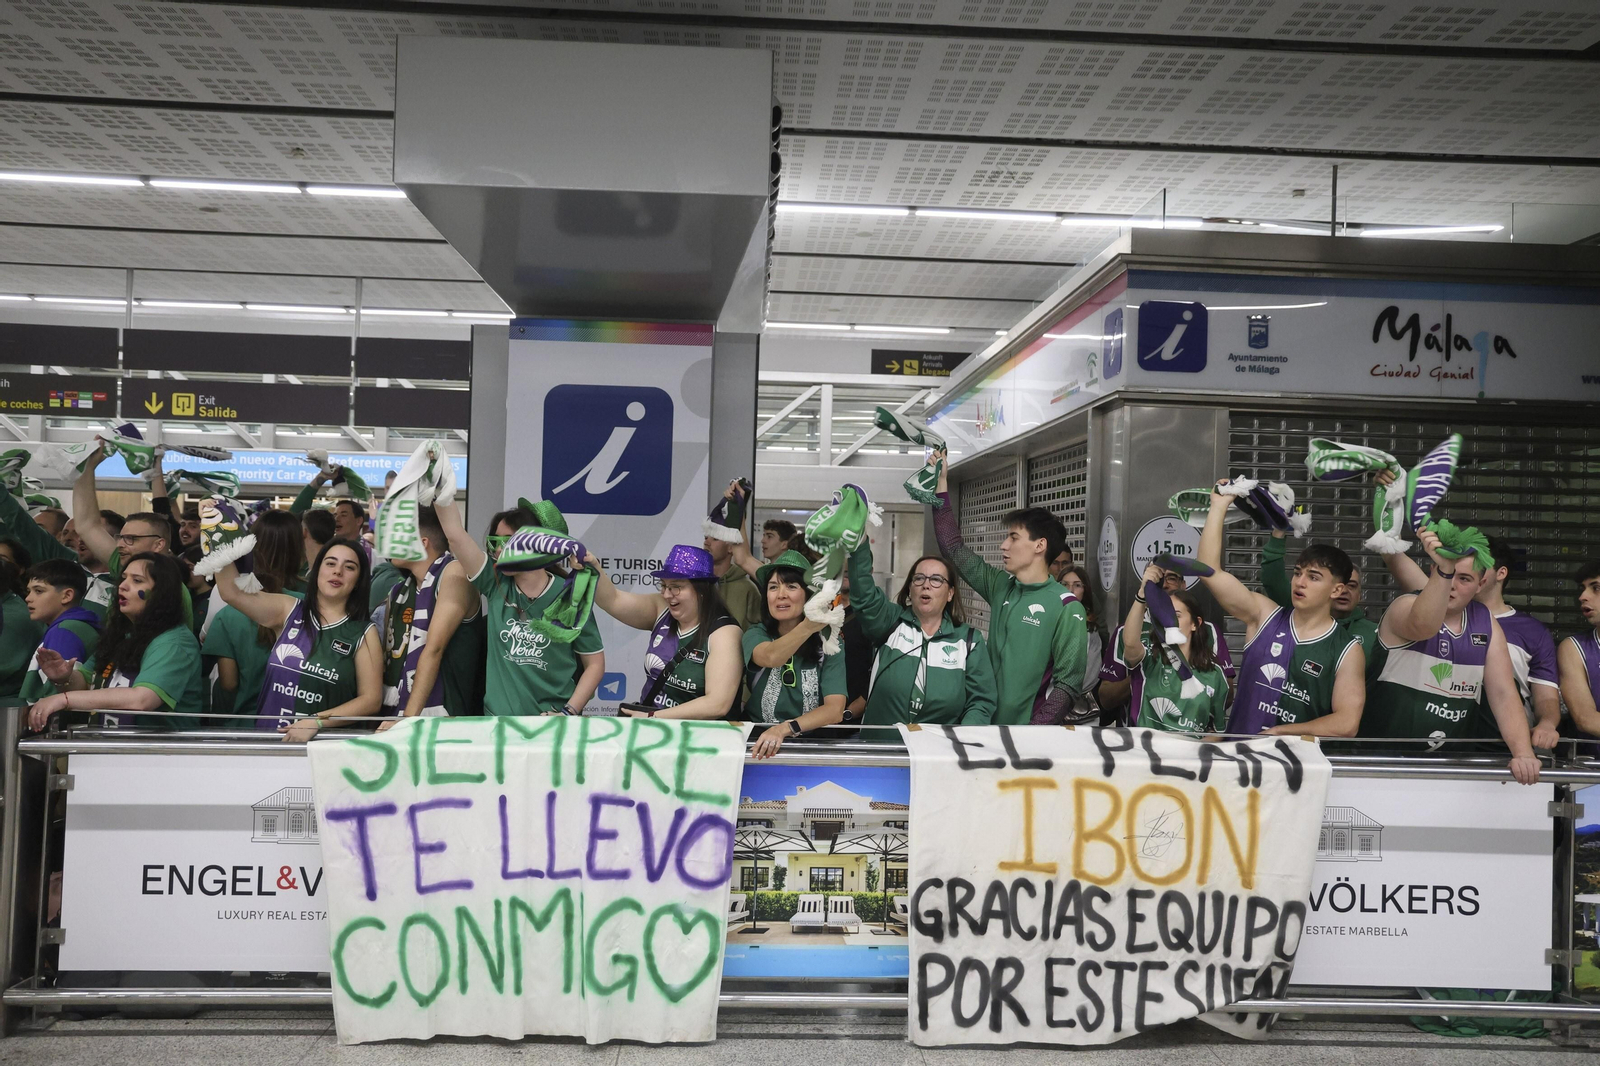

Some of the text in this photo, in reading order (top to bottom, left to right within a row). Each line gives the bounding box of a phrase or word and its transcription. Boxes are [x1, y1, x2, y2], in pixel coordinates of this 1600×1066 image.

[1372, 305, 1517, 391] Málaga
[1228, 353, 1288, 363] Ayuntamiento
[1235, 364, 1280, 375] de Málaga
[1370, 364, 1475, 382] Ciudad Genial
[10, 400, 44, 409] coches
[198, 395, 216, 405] Exit
[198, 406, 237, 418] Salida
[240, 456, 275, 465] nuevo
[230, 468, 274, 482] Priority
[277, 470, 295, 480] Car
[299, 659, 340, 681] Unicaja
[341, 716, 744, 806] SIEMPRE
[942, 724, 1305, 793] EL PLAN
[997, 776, 1260, 889] IBON
[325, 790, 736, 901] TE LLEVO
[1309, 877, 1480, 916] VÖLKERS
[217, 910, 264, 921] LUXURY
[267, 911, 297, 921] REAL
[911, 876, 1307, 963] GRACIAS EQUIPO
[1305, 925, 1409, 937] ESTATE MARBELLA
[917, 952, 1030, 1033] POR
[1045, 957, 1168, 1033] ESTE
